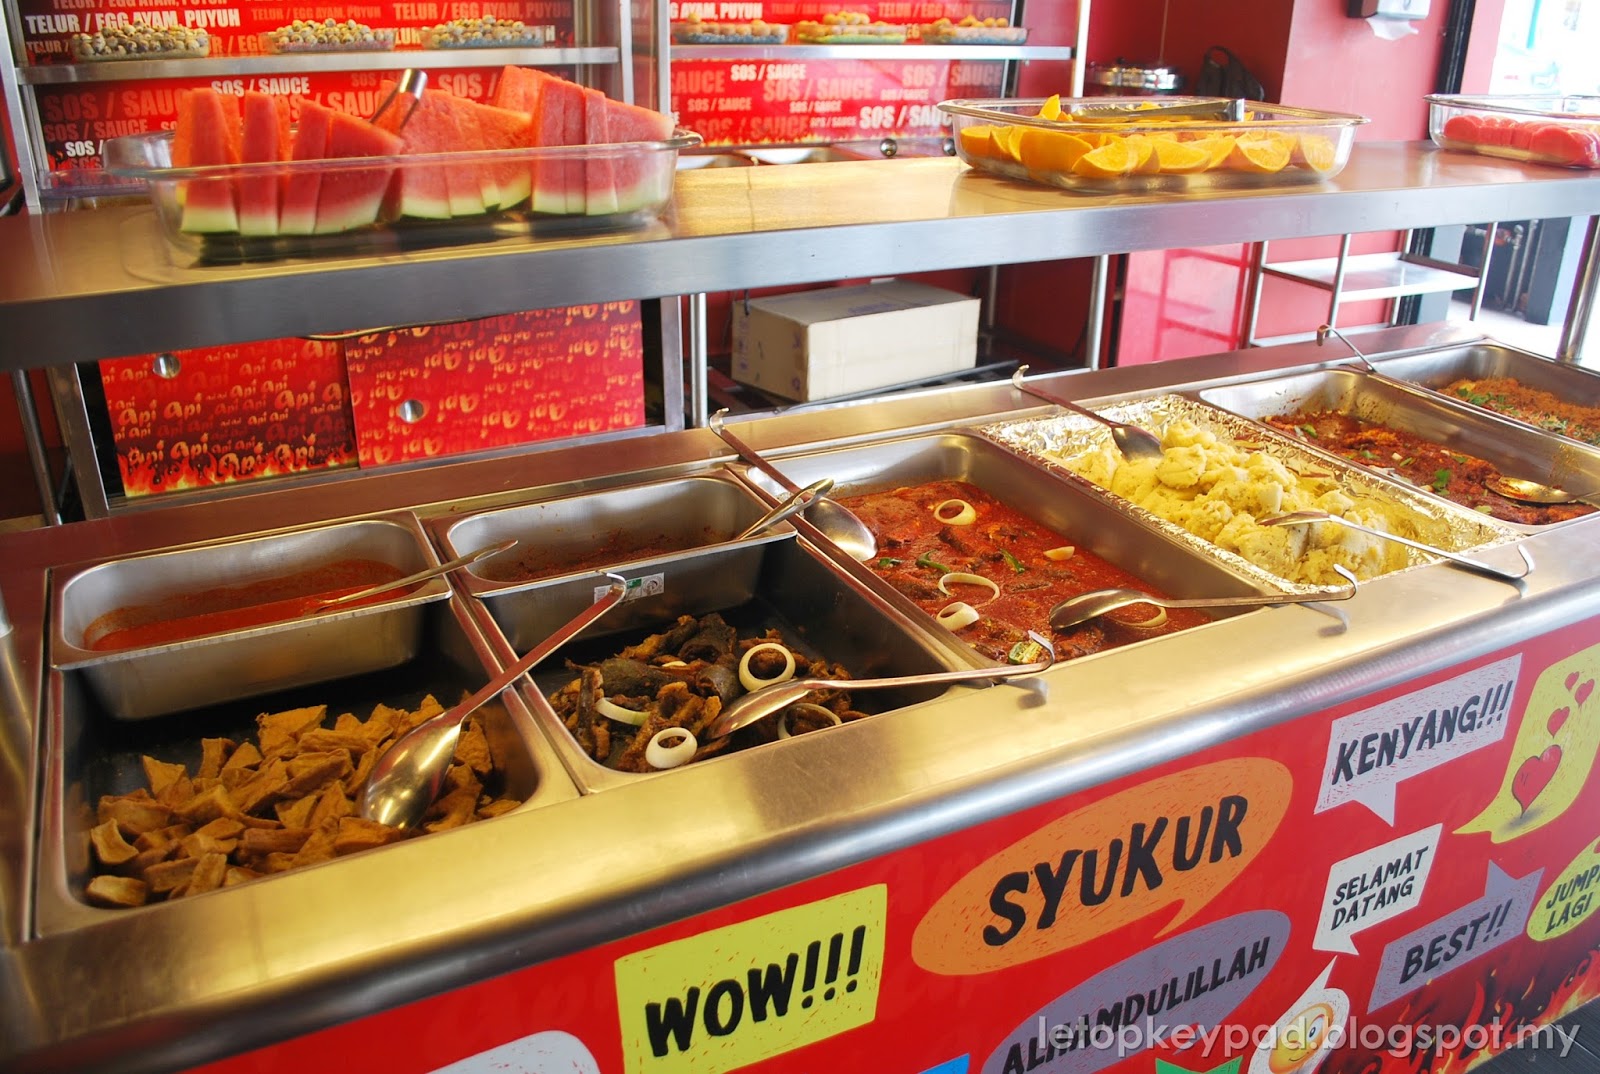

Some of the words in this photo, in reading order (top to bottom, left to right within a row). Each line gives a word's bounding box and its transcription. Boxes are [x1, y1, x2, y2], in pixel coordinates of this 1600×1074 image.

[25, 14, 80, 34] TELUR
[184, 9, 240, 29] PUYUH
[393, 3, 438, 20] TELUR
[451, 3, 479, 19] EGG
[720, 2, 763, 19] PUYUH
[671, 70, 726, 94] AUCE
[731, 64, 757, 81] SOS
[767, 63, 807, 80] SAUCE
[902, 64, 937, 87] SOS
[211, 78, 245, 97] SOS
[258, 77, 311, 96] SAUCE
[438, 72, 483, 98] SOS
[763, 79, 801, 103] SOS
[816, 78, 873, 100] SAUCE
[327, 90, 380, 118] SAU
[688, 98, 710, 112] SOS
[718, 97, 752, 111] SAUCE
[860, 105, 896, 129] SOS
[909, 104, 952, 127] SAUC
[93, 119, 149, 140] SAUCE
[64, 140, 97, 158] SOS
[1331, 680, 1513, 785] KENYANG!!!
[983, 795, 1248, 946] SYUKUR
[1333, 846, 1428, 905] SELAMAT
[1546, 865, 1600, 909] JUMP
[1331, 876, 1415, 931] DATANG
[1545, 892, 1594, 934] LAGI
[1399, 899, 1513, 985] BEST!!
[645, 925, 866, 1057] WOW!!!
[1001, 936, 1271, 1074] ALHAMDULILLAH
